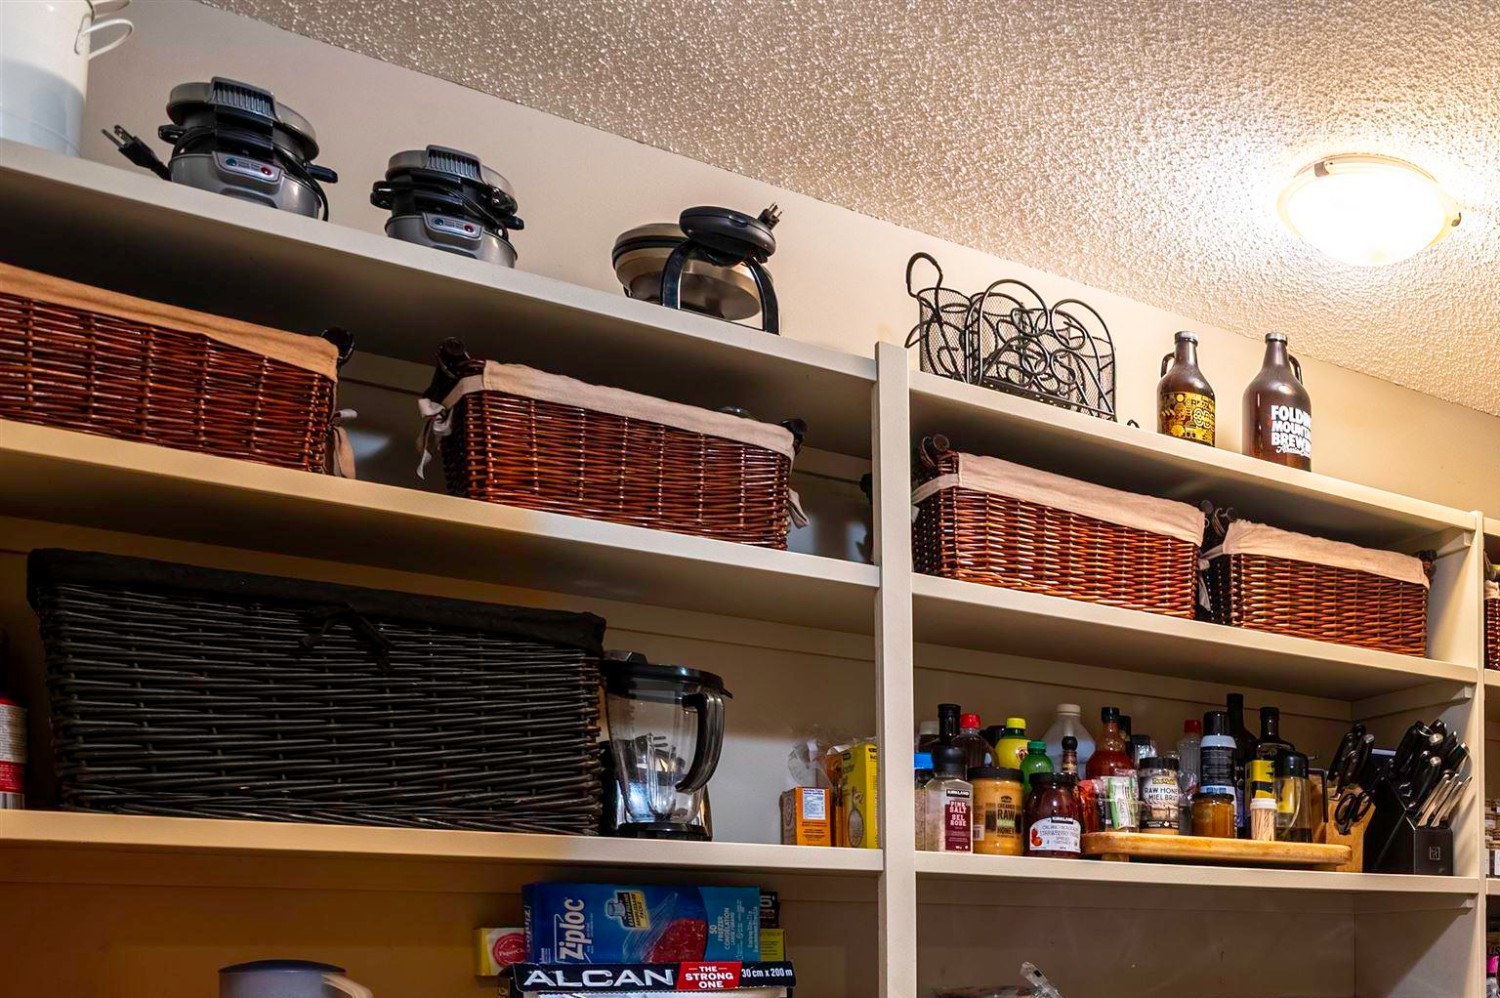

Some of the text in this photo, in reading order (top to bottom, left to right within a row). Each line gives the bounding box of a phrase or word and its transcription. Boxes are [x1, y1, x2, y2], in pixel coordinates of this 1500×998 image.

[997, 809, 1015, 820] RAW
[558, 899, 592, 961] Ziploc
[685, 973, 734, 981] STRONG
[741, 968, 751, 978] 30
[752, 970, 763, 978] cm
[770, 968, 785, 977] 200
[786, 969, 793, 977] m
[523, 969, 674, 988] ALCAN
[698, 980, 724, 988] ONE
